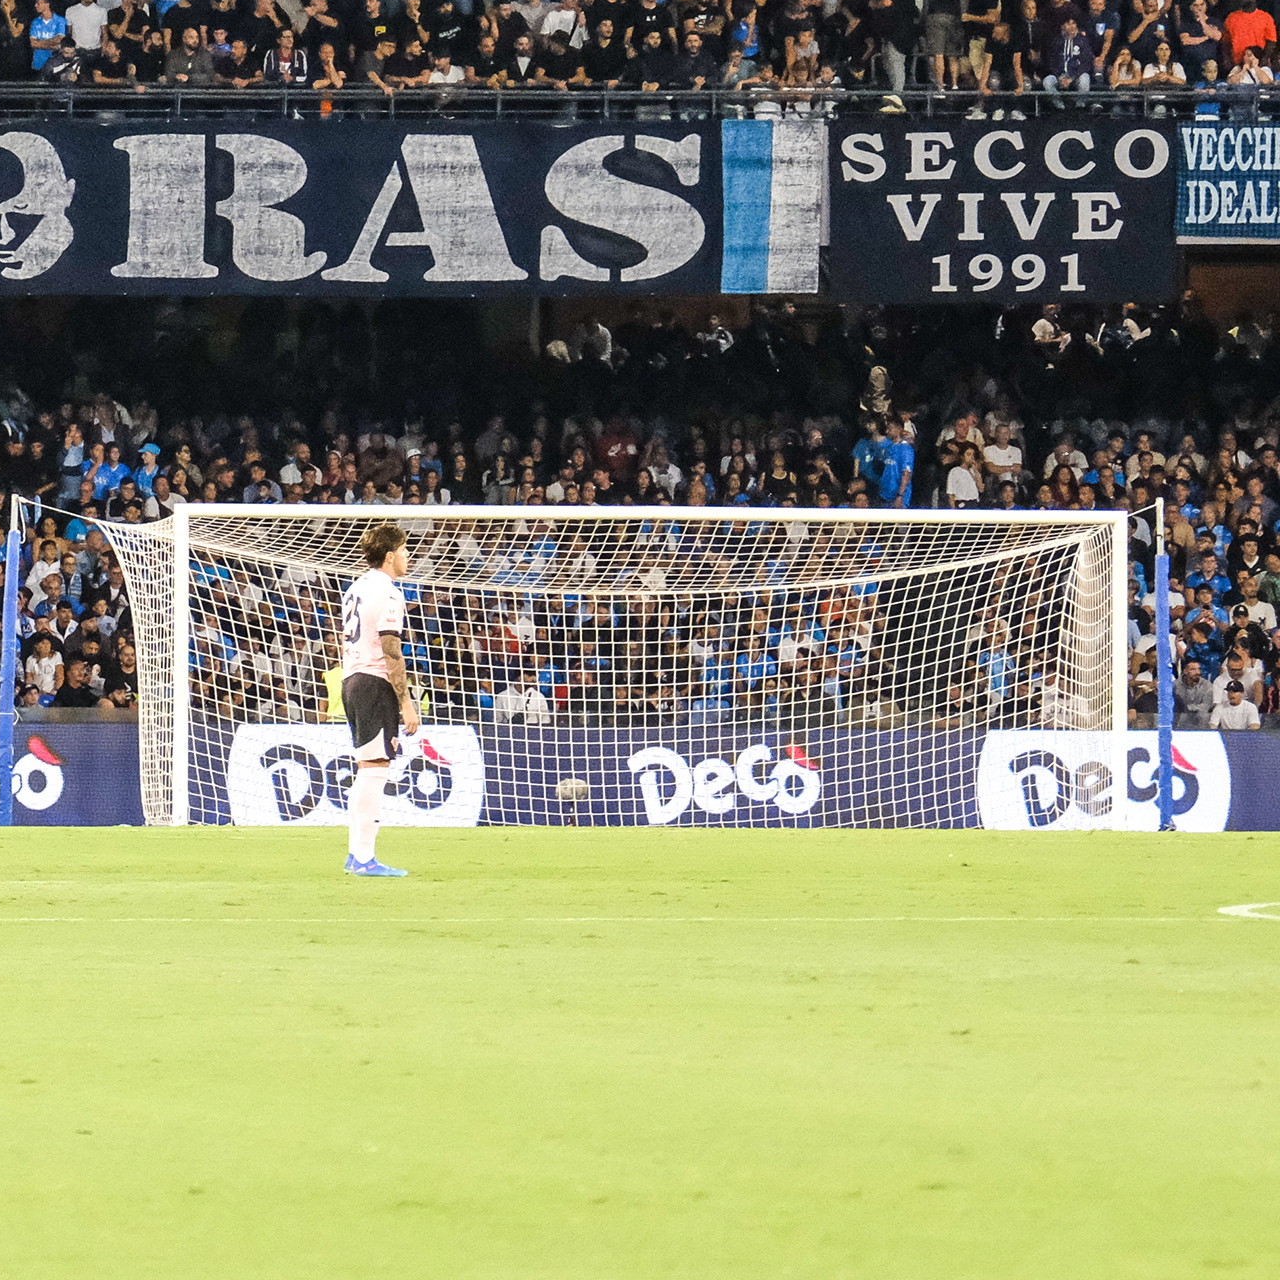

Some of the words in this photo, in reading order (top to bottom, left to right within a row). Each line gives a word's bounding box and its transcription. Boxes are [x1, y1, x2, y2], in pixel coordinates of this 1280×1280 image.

[840, 128, 1170, 183] SECCO
[886, 191, 1124, 242] VIVE
[1185, 179, 1280, 225] IDEAL
[931, 252, 1087, 293] 1991
